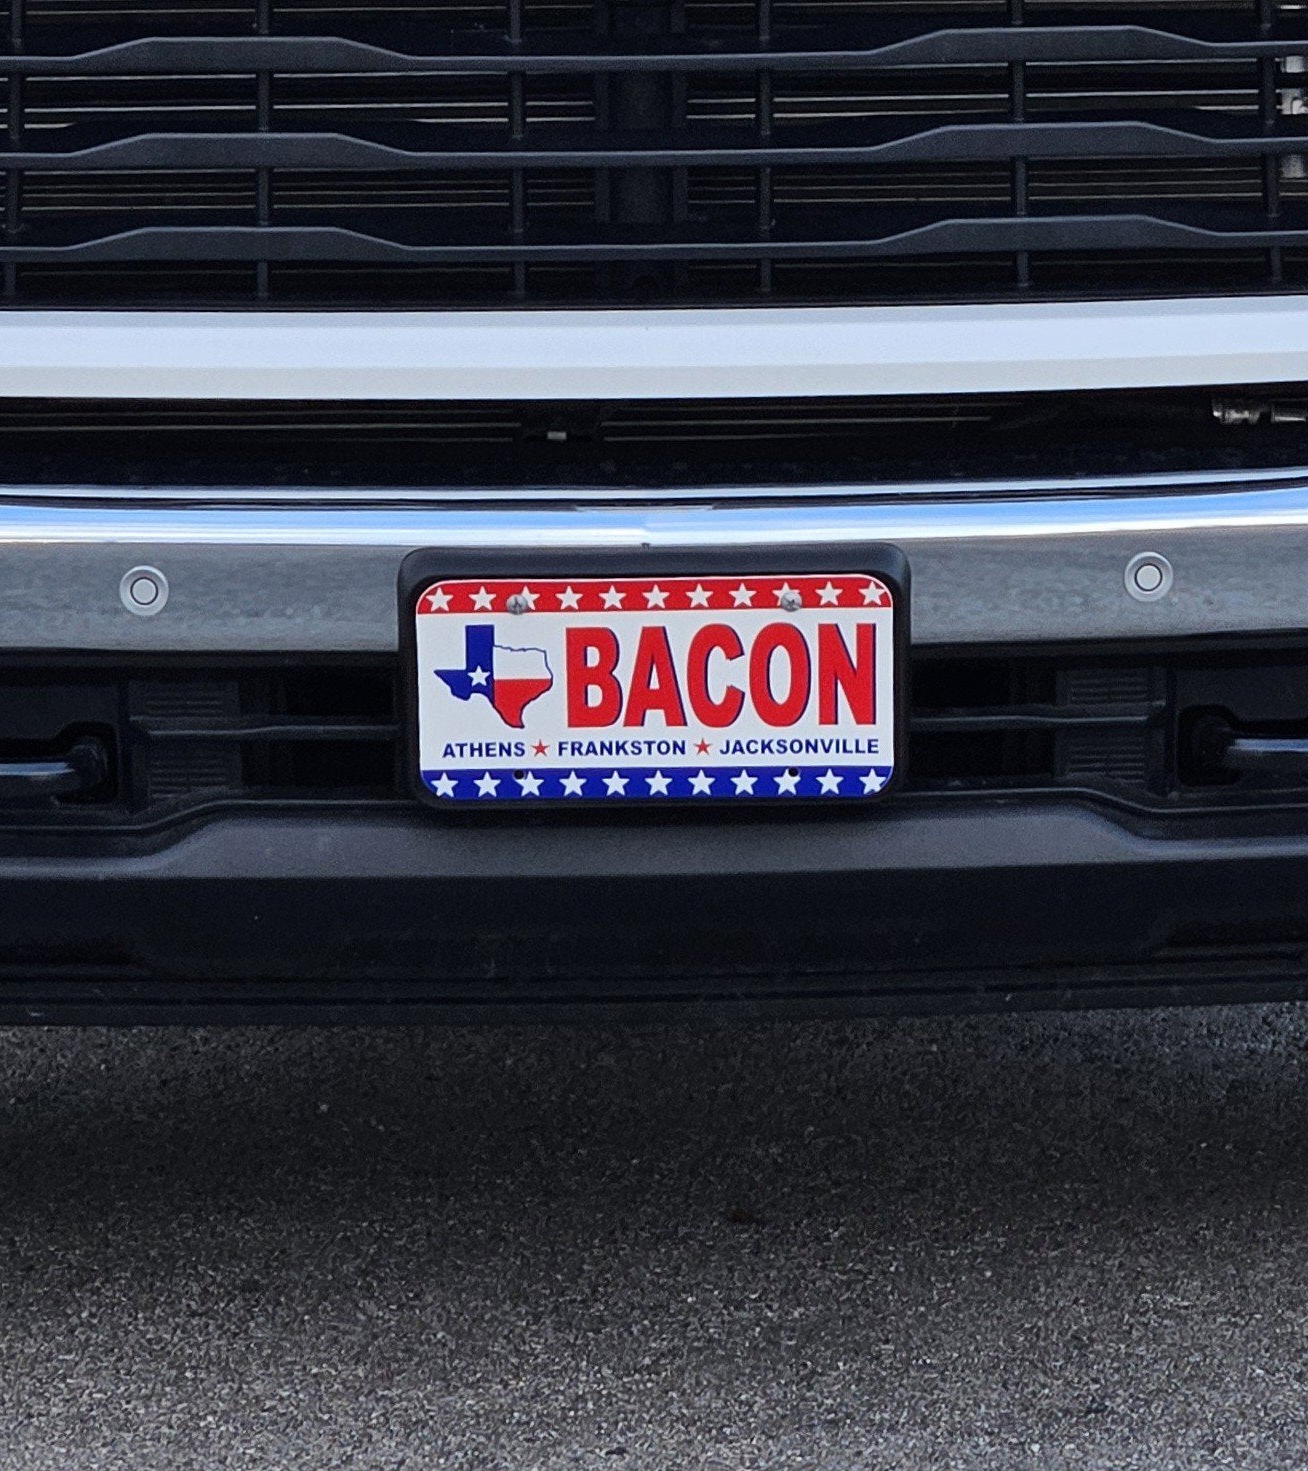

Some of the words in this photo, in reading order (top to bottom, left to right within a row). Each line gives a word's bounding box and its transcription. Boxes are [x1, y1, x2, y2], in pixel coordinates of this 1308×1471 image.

[565, 622, 876, 728] BACON
[442, 741, 526, 758] ATHENS
[557, 740, 686, 757] FRANKSTON
[719, 738, 879, 755] JACKSONVILLE
